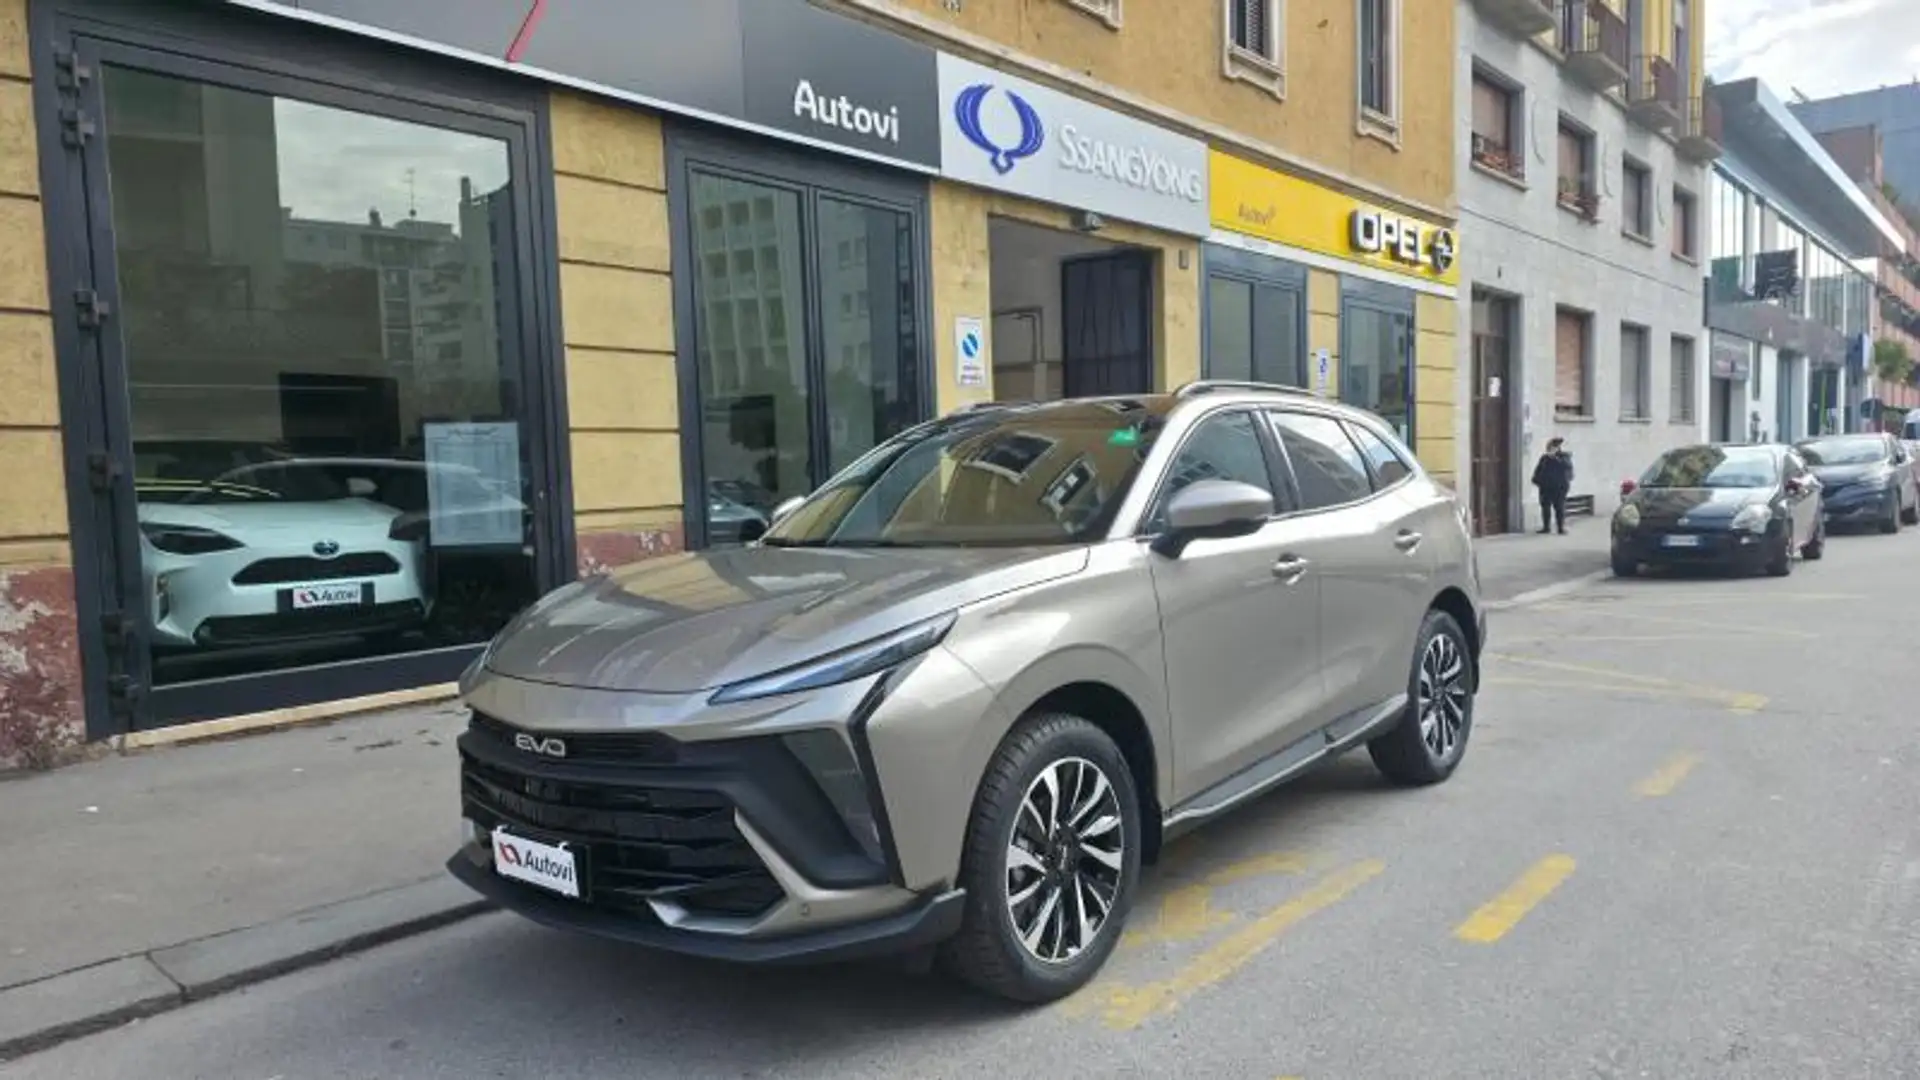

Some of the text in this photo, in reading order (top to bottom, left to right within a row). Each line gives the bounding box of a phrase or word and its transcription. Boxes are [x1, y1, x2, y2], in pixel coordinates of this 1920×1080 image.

[794, 79, 899, 142] Autovi
[1353, 208, 1432, 264] OPEL
[515, 732, 566, 757] EVO
